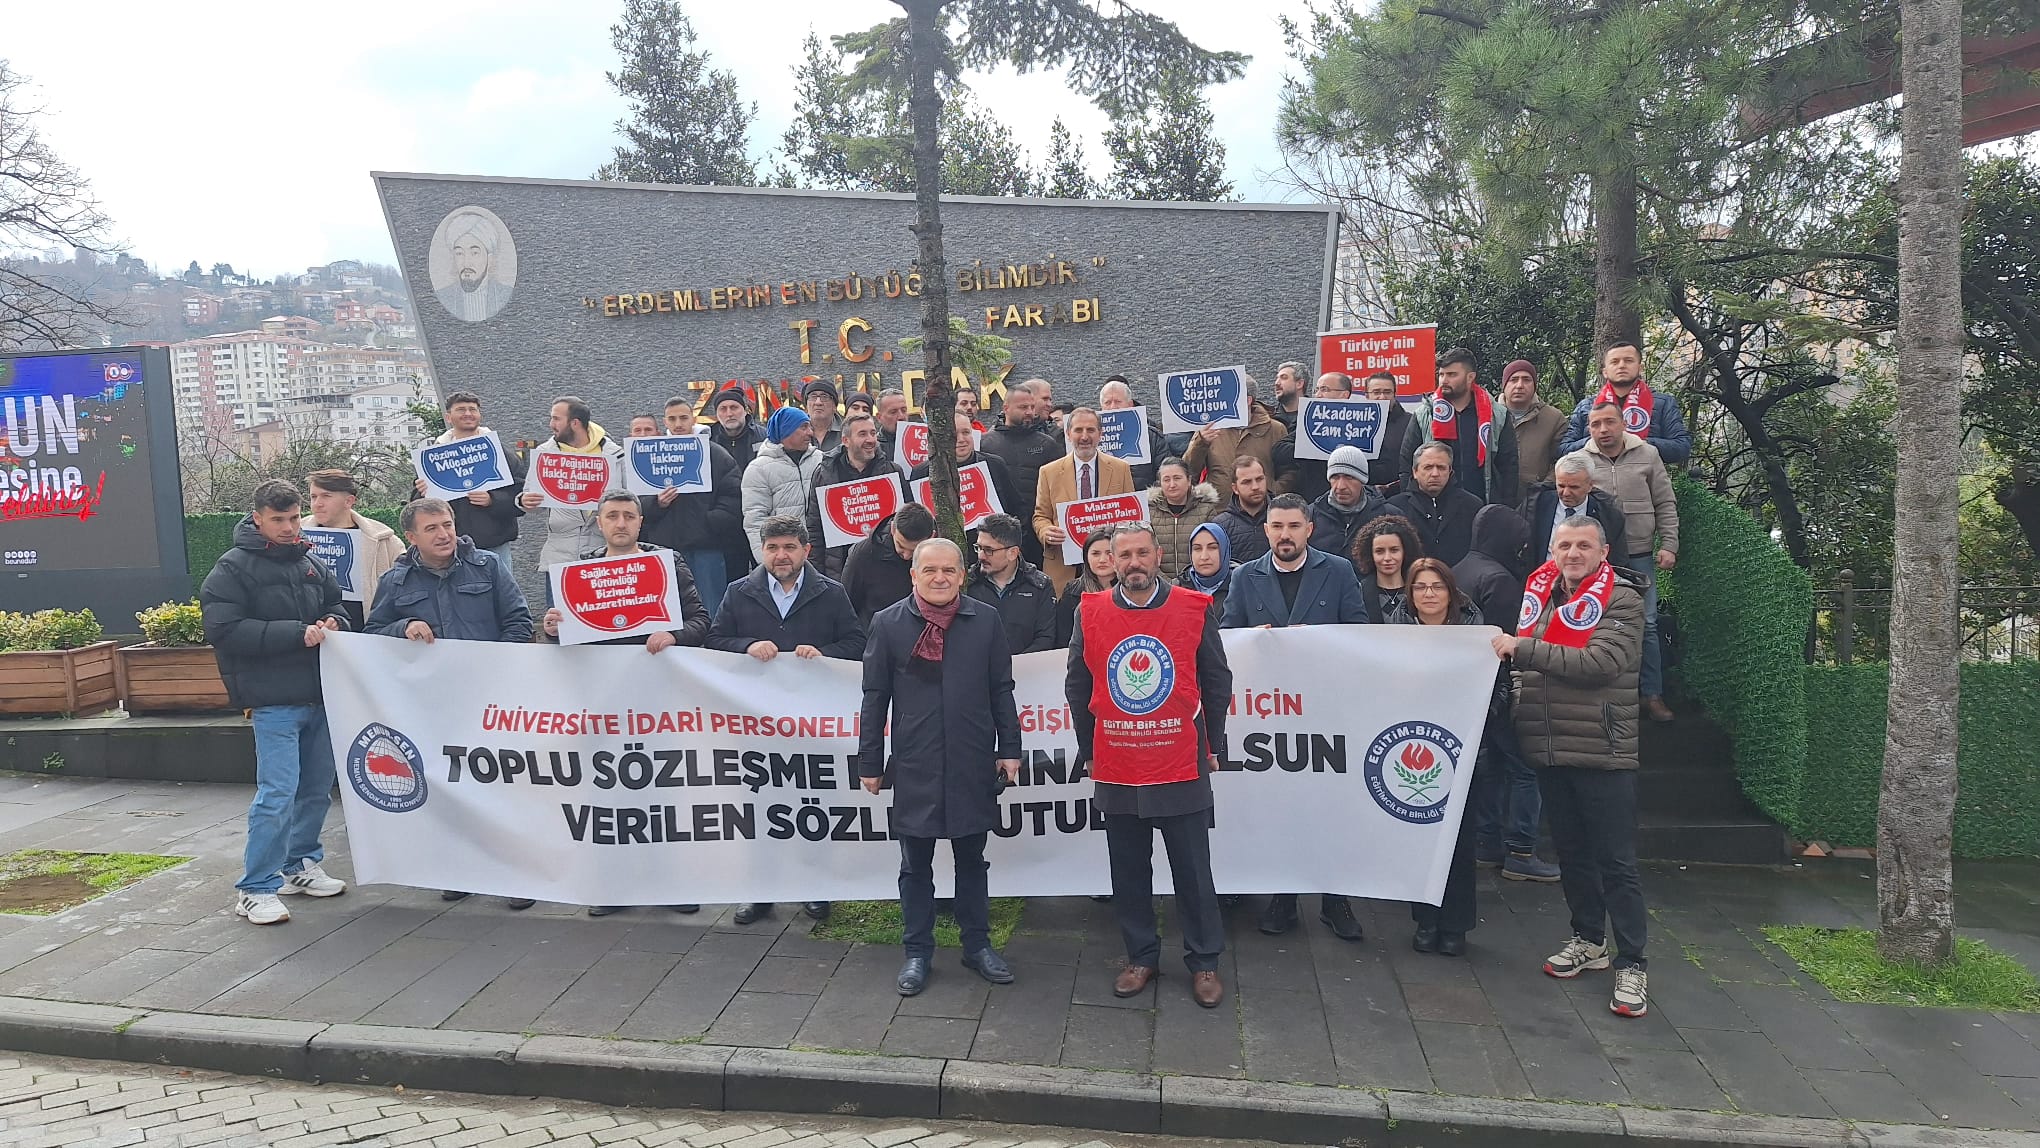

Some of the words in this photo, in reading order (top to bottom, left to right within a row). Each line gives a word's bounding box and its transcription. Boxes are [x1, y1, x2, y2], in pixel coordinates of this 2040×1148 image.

[780, 280, 817, 305] EN
[826, 266, 921, 301] BÜYÜĞ
[1346, 357, 1362, 370] En
[1367, 354, 1409, 370] Büyük
[1183, 387, 1220, 401] Sözler
[1178, 400, 1228, 415] Tutulsun
[1311, 404, 1376, 422] Akademik
[0, 394, 79, 457] UN
[1311, 421, 1342, 438] Zam
[1344, 424, 1373, 441] Şart
[428, 450, 459, 463] Çözüm
[459, 442, 488, 455] Yoksa
[659, 440, 698, 452] Personel
[434, 453, 489, 472] Mücadele
[542, 455, 559, 467] Yer
[454, 466, 475, 478] Var
[570, 469, 604, 482] Adaleti
[557, 479, 588, 492] Sağlar
[848, 484, 868, 496] Toplu
[1084, 501, 1120, 513] Makam
[1115, 508, 1137, 519] Daire
[847, 512, 880, 525] Uyulsun
[580, 567, 611, 580] Sağlık
[611, 567, 624, 575] ve
[626, 562, 646, 574] Aile
[590, 575, 638, 589] Bütünlüğü
[595, 586, 637, 599] Bizimde
[575, 594, 660, 613] Mazeretimizdir
[1245, 688, 1303, 719] İÇİN
[482, 704, 621, 735] ÜNİVERSİTE
[627, 707, 703, 736] İDARİ
[443, 745, 583, 787] TOPLU
[592, 742, 838, 794] SÖZLEŞME
[561, 803, 756, 845] VERİLEN
